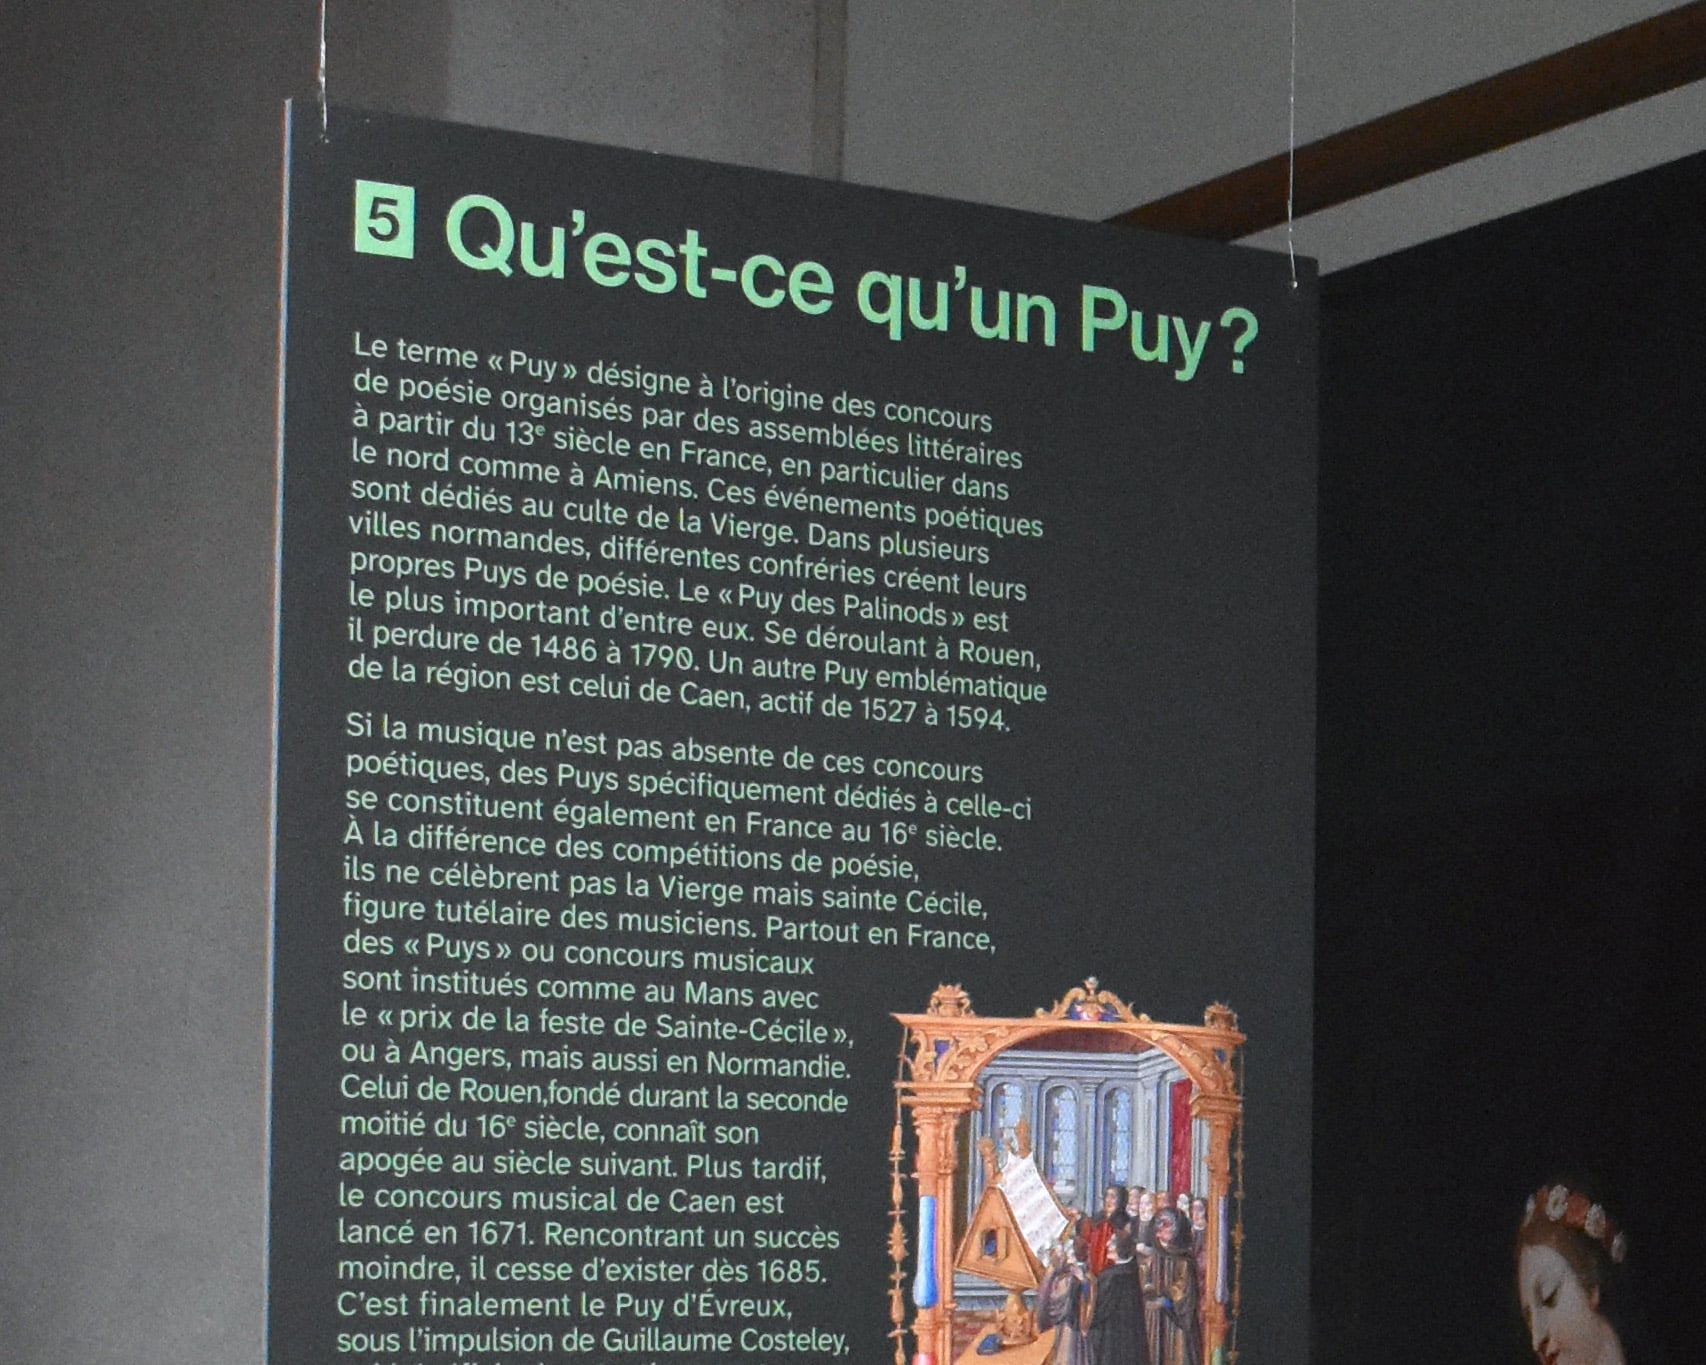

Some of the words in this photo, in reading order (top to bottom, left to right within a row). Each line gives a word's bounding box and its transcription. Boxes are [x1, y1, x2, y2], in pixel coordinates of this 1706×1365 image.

[366, 198, 401, 242] 5
[445, 194, 835, 315] Qu’est-ce
[857, 264, 1057, 348] qu’un
[352, 366, 390, 395] de
[398, 375, 492, 406] poésie
[499, 389, 633, 423] organisés
[641, 405, 687, 429] par
[692, 406, 741, 436] des
[747, 418, 900, 455] assemblées
[907, 430, 1023, 469] littéraires
[351, 434, 378, 464] le
[386, 445, 450, 472] nord
[458, 454, 561, 484] comme
[568, 460, 585, 487] à
[592, 464, 699, 499] Amiens.
[706, 476, 757, 505] Ces
[763, 483, 917, 523] événements
[924, 505, 1044, 539] poétiques
[347, 508, 422, 541] villes
[429, 522, 592, 561] normandes,
[599, 533, 741, 572] différentes
[748, 552, 876, 586] confréries
[883, 565, 961, 595] créent
[968, 571, 1028, 602] leurs
[348, 578, 376, 608] le
[384, 583, 445, 614] plus
[453, 588, 591, 627] important
[599, 603, 694, 636] d’entre
[701, 618, 755, 642] eux.
[763, 618, 798, 646] Se
[805, 623, 928, 658] déroulant
[934, 634, 950, 660] à
[958, 637, 1041, 673] Rouen,
[345, 749, 491, 786] poétiques,
[498, 757, 549, 786] des
[556, 761, 619, 794] Puys
[627, 769, 827, 806] spécifiquement
[833, 781, 917, 813] dédiés
[923, 788, 938, 814] à
[945, 792, 1032, 821] celle-ci
[342, 812, 365, 846] À
[372, 819, 398, 848] la
[406, 822, 547, 857] différence
[555, 831, 604, 860] des
[612, 839, 783, 871] compétitions
[790, 846, 823, 873] de
[830, 851, 920, 883] poésie,
[341, 889, 427, 925] figure
[434, 898, 552, 927] tutélaire
[559, 902, 609, 930] des
[618, 907, 758, 939] musiciens.
[766, 914, 861, 943] Partout
[867, 925, 898, 945] en
[907, 922, 997, 955] France,
[341, 968, 403, 992] sont
[410, 965, 529, 998] institués
[536, 978, 637, 1001] comme
[643, 982, 675, 1003] au
[684, 979, 754, 1007] Mans
[761, 988, 820, 1010] avec
[340, 1042, 376, 1063] ou
[384, 1036, 401, 1064] à
[408, 1038, 512, 1072] Angers,
[520, 1042, 584, 1070] mais
[591, 1046, 658, 1073] aussi
[666, 1053, 698, 1074] en
[706, 1049, 852, 1079] Normandie.
[338, 1146, 444, 1178] apogée
[451, 1152, 484, 1174] au
[493, 1148, 572, 1176] siècle
[579, 1150, 678, 1177] suivant.
[686, 1152, 743, 1179] Plus
[751, 1153, 827, 1185] tardif,
[338, 1179, 365, 1208] le
[373, 1187, 503, 1210] concours
[512, 1184, 618, 1212] musical
[626, 1185, 661, 1213] de
[668, 1187, 736, 1214] Caen
[744, 1191, 785, 1215] est
[338, 1215, 415, 1244] lancé
[422, 1224, 458, 1245] en
[467, 1219, 535, 1246] 1671.
[544, 1220, 705, 1248] Rencontrant
[713, 1228, 745, 1248] un
[753, 1223, 841, 1249] succès
[337, 1253, 462, 1285] moindre,
[469, 1253, 487, 1281] il
[494, 1260, 574, 1282] cesse
[581, 1255, 695, 1282] d’exister
[701, 1256, 749, 1283] dès
[756, 1258, 828, 1284] 1685.
[336, 1290, 409, 1317] C’est
[418, 1288, 572, 1317] finalement
[580, 1290, 606, 1317] le
[615, 1291, 665, 1322] Puy
[672, 1286, 793, 1321] d'Évreux,
[336, 1331, 401, 1353] sous
[408, 1325, 554, 1357] l’impulsion
[561, 1325, 596, 1353] de
[602, 1325, 733, 1352] Guillaume
[739, 1325, 850, 1357] Costeley,
